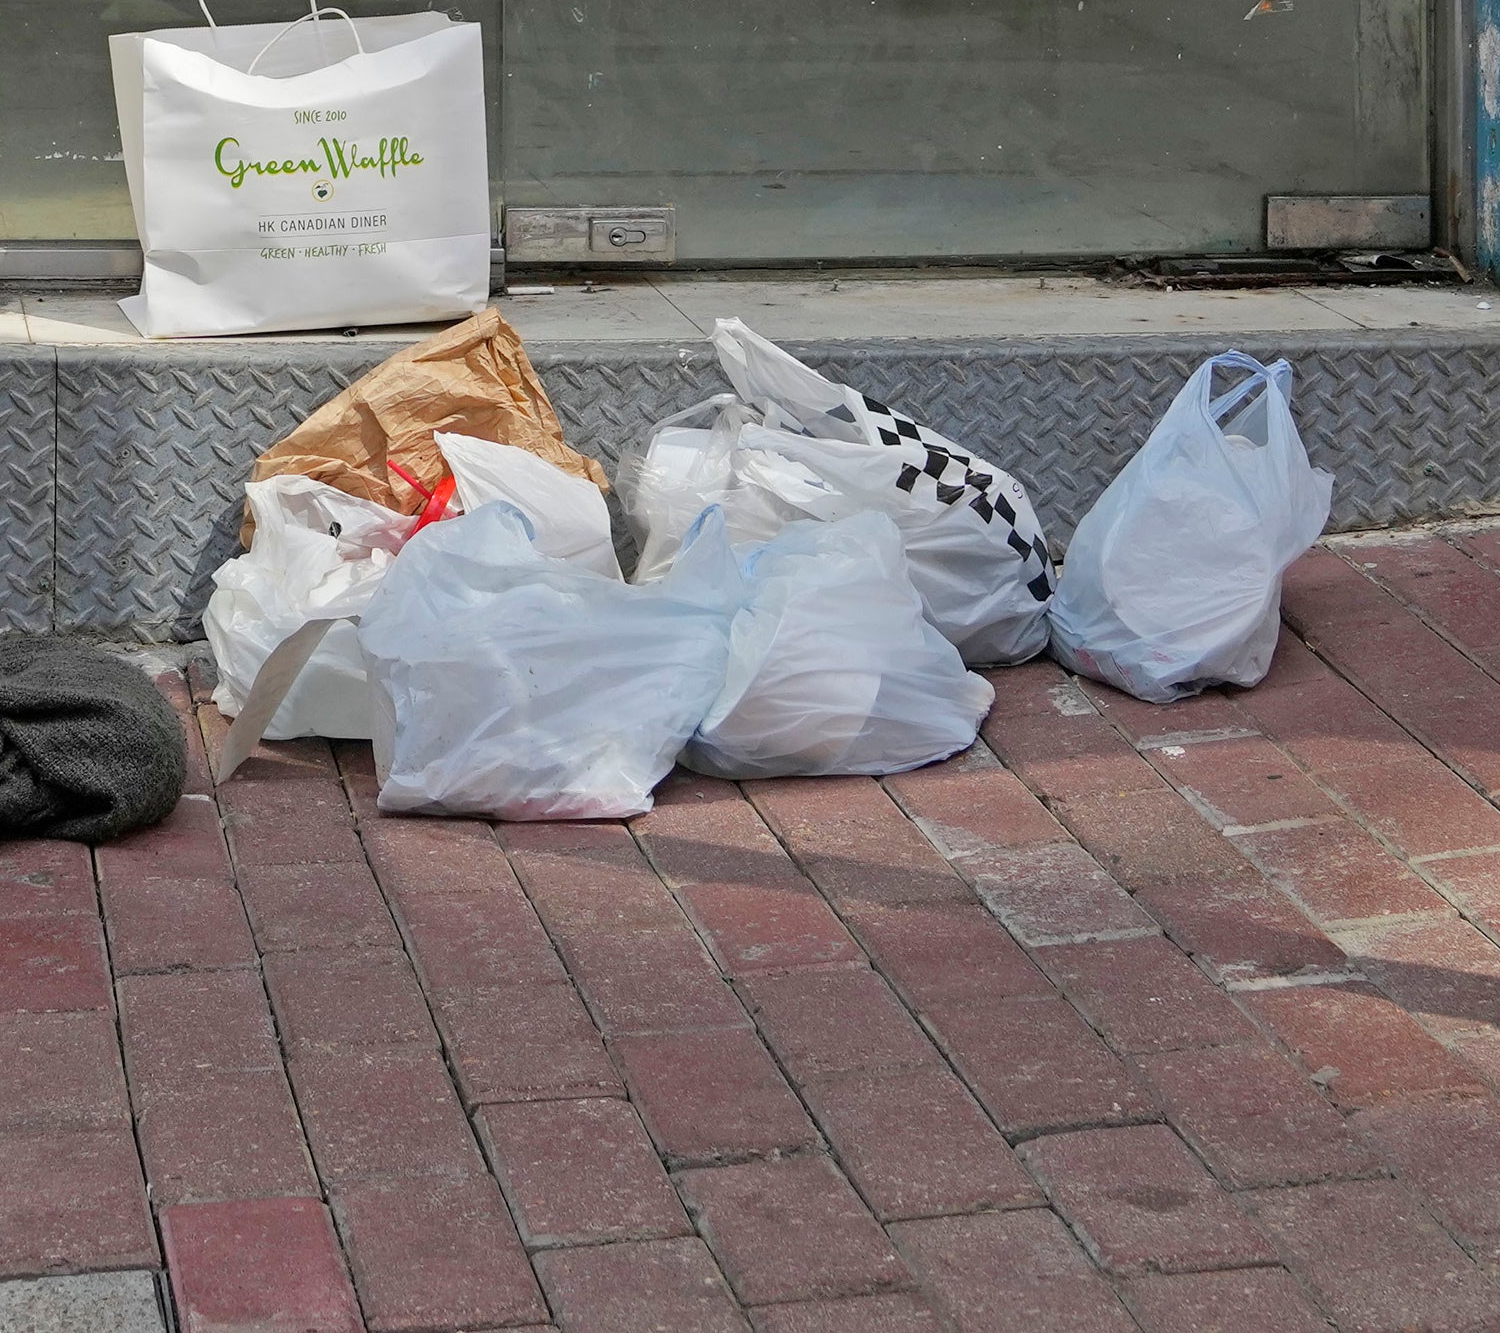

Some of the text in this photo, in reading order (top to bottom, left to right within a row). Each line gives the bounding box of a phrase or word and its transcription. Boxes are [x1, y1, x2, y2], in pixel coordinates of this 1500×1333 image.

[293, 108, 348, 125] SINCE 2010
[213, 136, 425, 189] Green Waffle
[258, 213, 388, 233] HK CANADIAN DINER
[260, 242, 387, 260] GREEN HEALTHY FRESH
